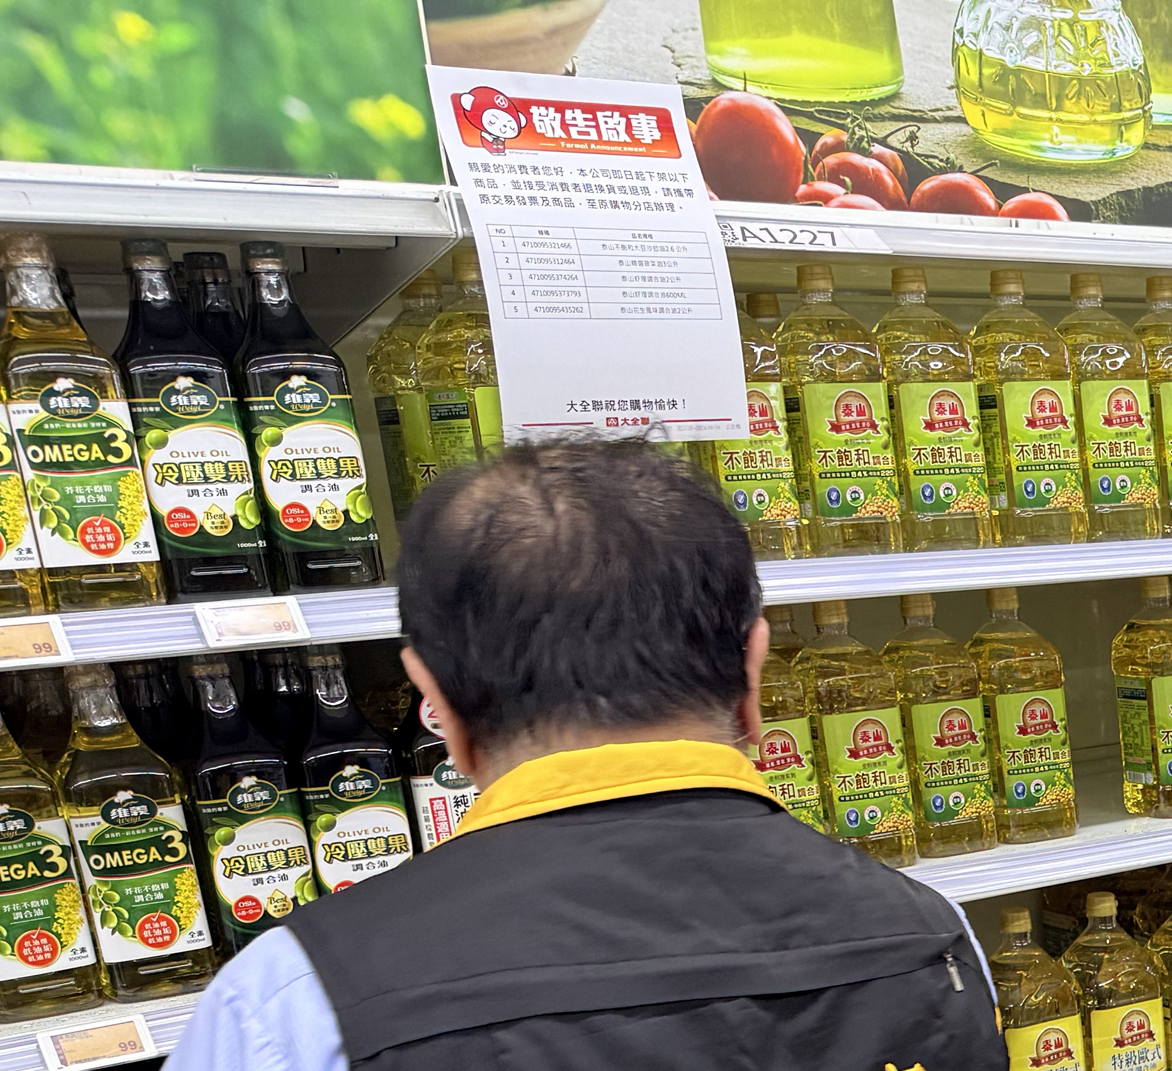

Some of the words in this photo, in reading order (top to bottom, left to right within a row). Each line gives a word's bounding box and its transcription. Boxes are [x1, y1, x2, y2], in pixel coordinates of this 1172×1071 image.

[529, 106, 661, 143] 敬告啟事
[591, 143, 647, 152] Announcement
[741, 226, 838, 248] A1227
[841, 403, 867, 417] 泰山
[935, 402, 959, 416] 泰山
[1036, 399, 1058, 414] 泰山
[1113, 398, 1134, 412] 泰山
[170, 450, 207, 458] OLIVE
[284, 447, 319, 455] OLIVE
[152, 461, 252, 487] 冷壓雙果
[268, 456, 363, 483] 冷壓雙果
[187, 488, 228, 498] 調合油
[300, 483, 339, 493] 調合油
[75, 495, 107, 503] 調合油
[204, 512, 227, 520] Best
[316, 507, 339, 515] Best
[273, 621, 290, 631] 99
[32, 642, 52, 653] 99
[1028, 709, 1048, 722] 泰山
[945, 719, 967, 733] 泰山
[859, 730, 884, 744] 泰山
[765, 740, 791, 755] 泰山
[337, 829, 370, 838] OLIVE
[236, 842, 269, 852] OLIVE
[272, 838, 290, 846] OIL
[322, 834, 409, 863] 冷壓雙果
[221, 846, 309, 878] 冷壓雙果
[352, 860, 389, 871] 調合油
[252, 874, 289, 886] 調合油
[134, 892, 164, 902] 調合油
[13, 908, 43, 920] 調合油
[118, 1041, 137, 1051] 99
[1111, 1045, 1162, 1069] 特級歐式
